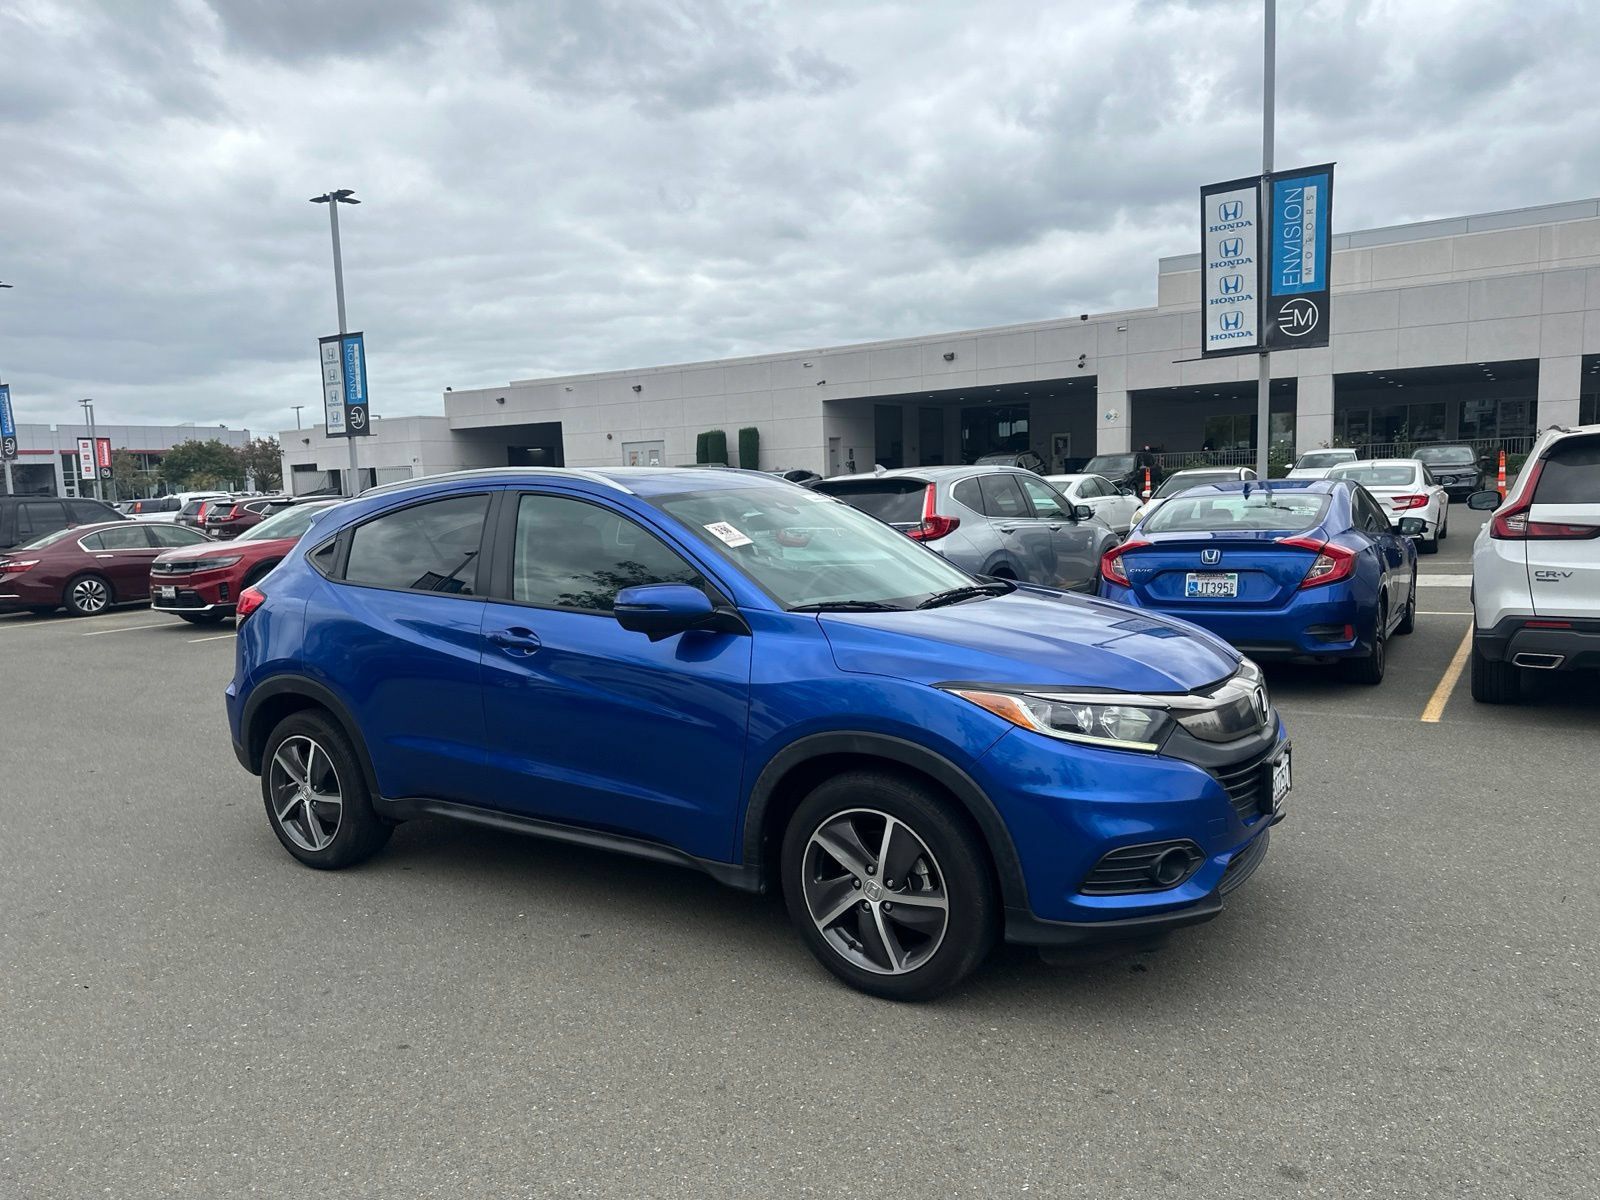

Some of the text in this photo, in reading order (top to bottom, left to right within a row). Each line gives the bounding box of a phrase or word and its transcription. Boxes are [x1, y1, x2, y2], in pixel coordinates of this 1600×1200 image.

[1209, 220, 1253, 233] HONDA
[1283, 188, 1303, 286] ENVISION
[1305, 194, 1314, 275] MOTORS
[1210, 257, 1253, 269] HONDA
[1210, 294, 1253, 305] HONDA
[1210, 330, 1253, 342] HONDA
[347, 344, 357, 400] ENVISION
[1535, 570, 1573, 578] CR-V
[1198, 582, 1229, 594] JT395
